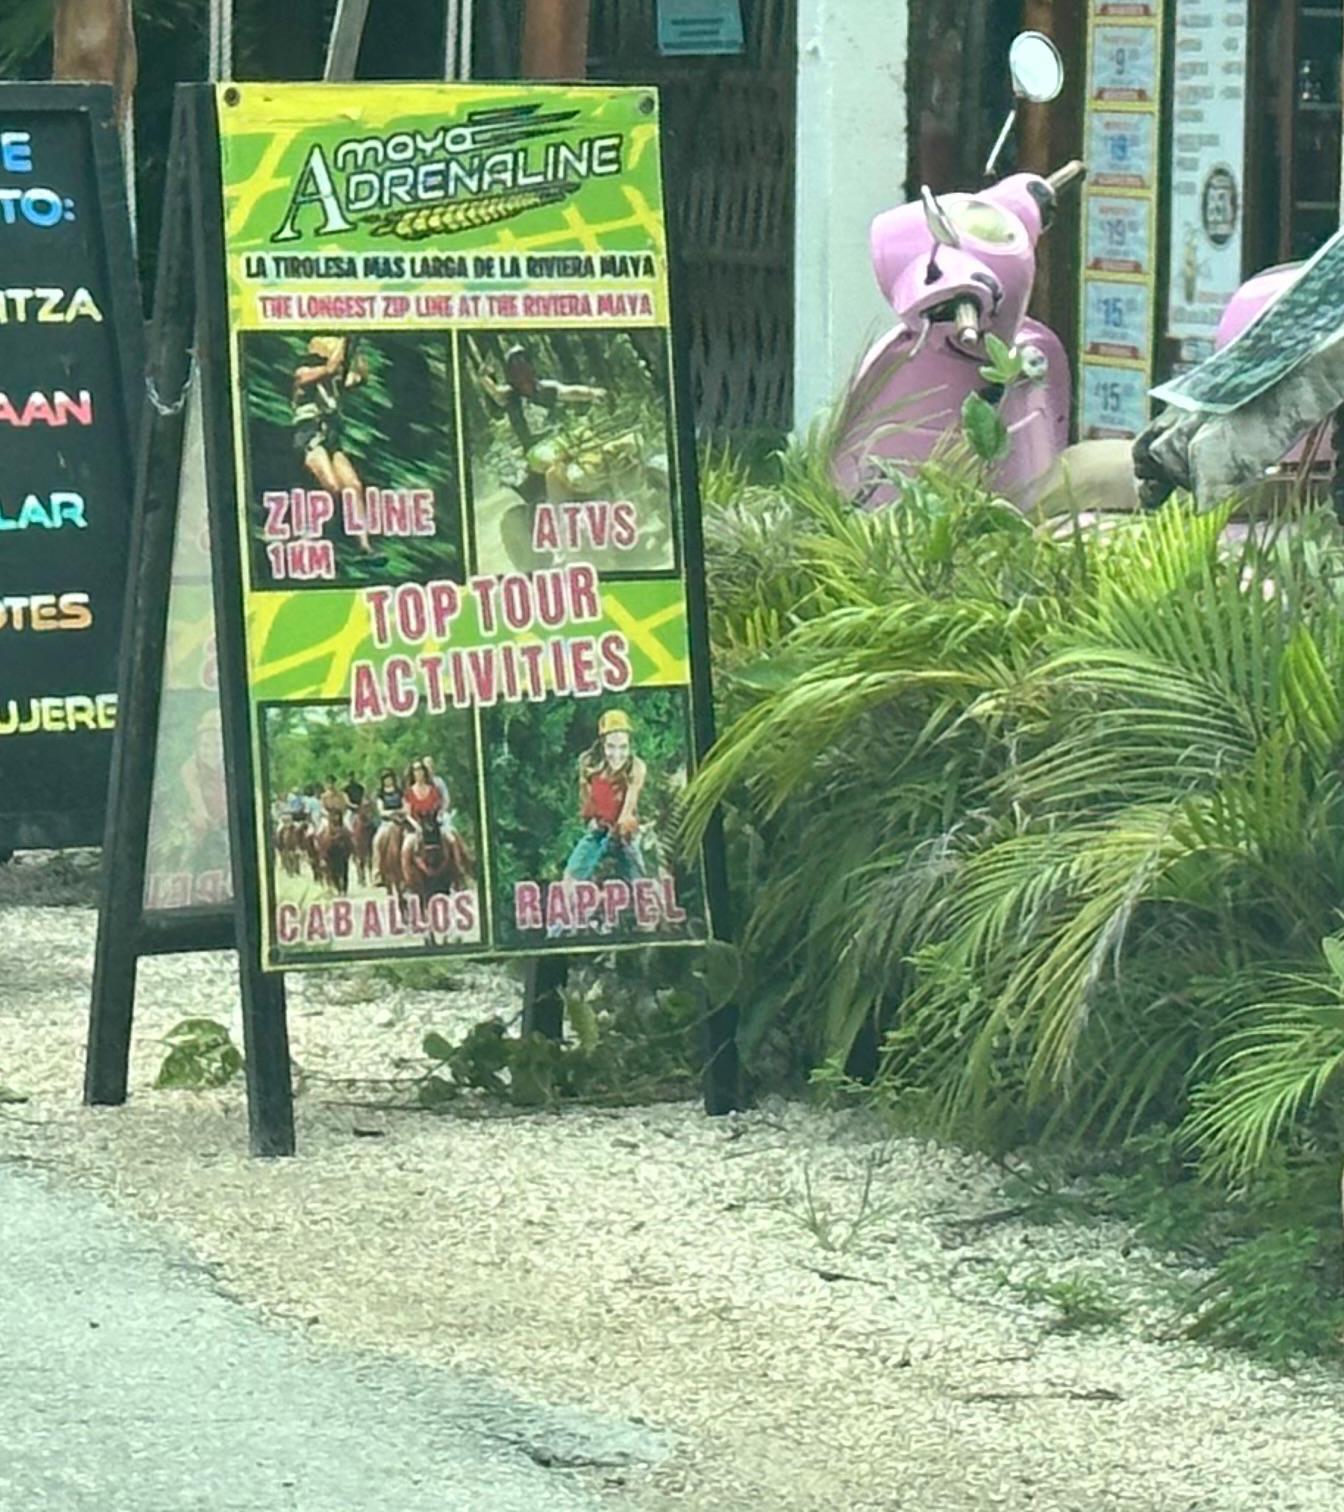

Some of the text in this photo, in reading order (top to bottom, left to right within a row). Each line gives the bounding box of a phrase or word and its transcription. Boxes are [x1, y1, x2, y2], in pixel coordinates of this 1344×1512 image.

[269, 134, 623, 243] ADRENALINE
[244, 254, 656, 280] LA TIROLESA MAS LARGA DE LA RIVIERA MAYA
[258, 293, 653, 320] THE LONGEST ZIP LINE AT THE RIVIERA MAYA
[262, 486, 436, 538] ZIP LINE
[532, 501, 639, 551] ATVS
[365, 561, 602, 647] TOP TOUR
[349, 633, 633, 723] ACTIVITIES
[275, 890, 477, 948] CABALLOS
[513, 874, 688, 932] RAPPEL
